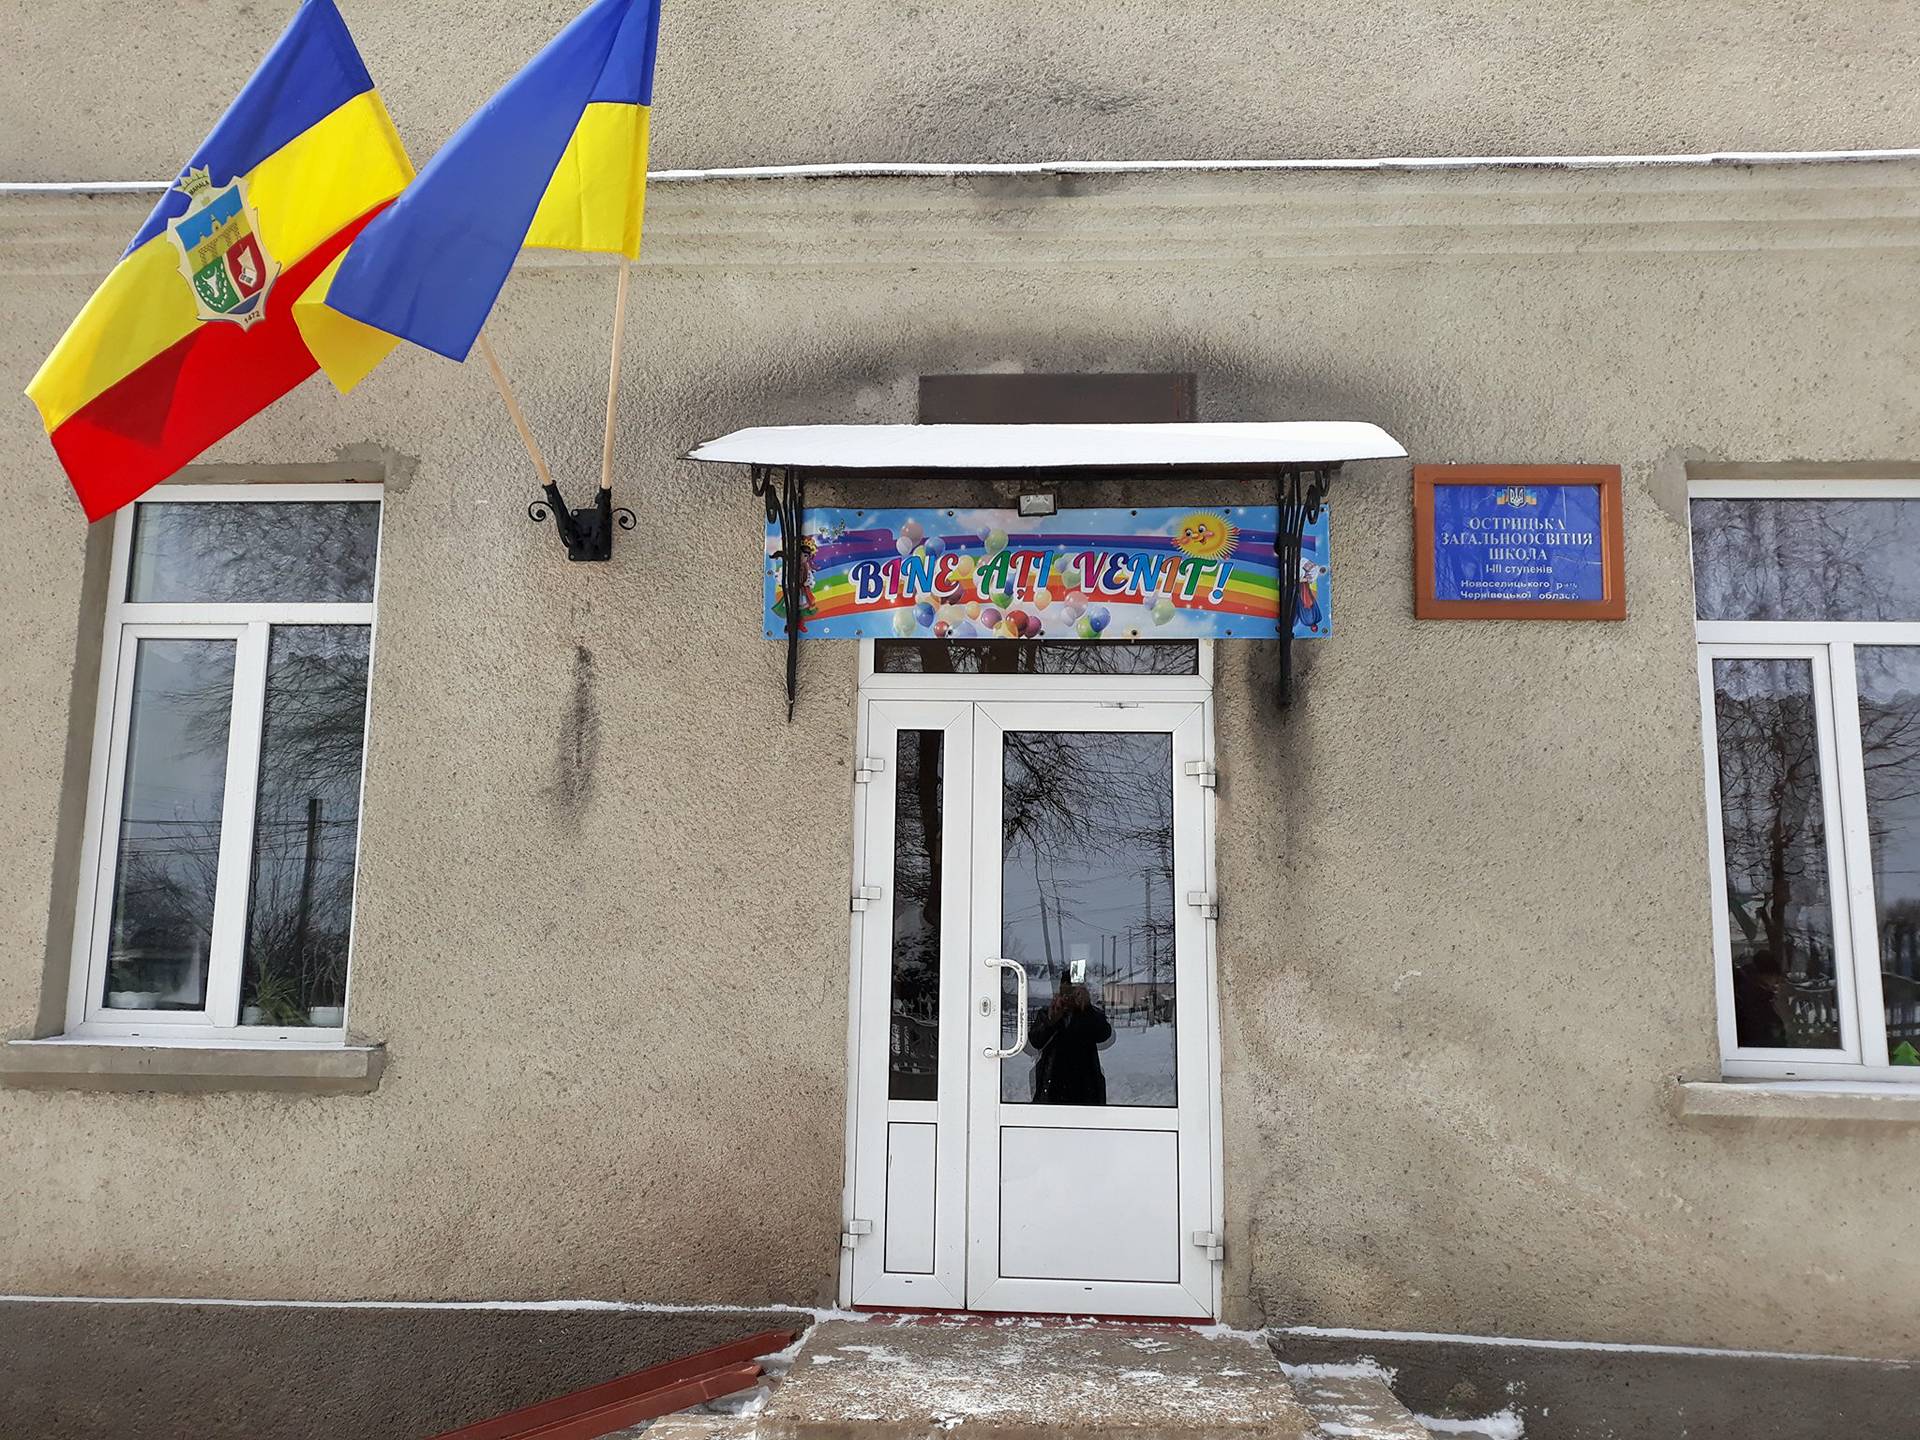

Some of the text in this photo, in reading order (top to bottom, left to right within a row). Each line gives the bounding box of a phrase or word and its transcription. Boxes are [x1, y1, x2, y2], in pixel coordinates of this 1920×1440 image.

[244, 310, 260, 324] 1472
[1489, 548, 1547, 560] ШКОЛА
[1504, 564, 1553, 575] ступенів
[850, 552, 959, 604] BINE
[1072, 550, 1234, 605] VENIT!
[1461, 580, 1551, 588] Новоселицького
